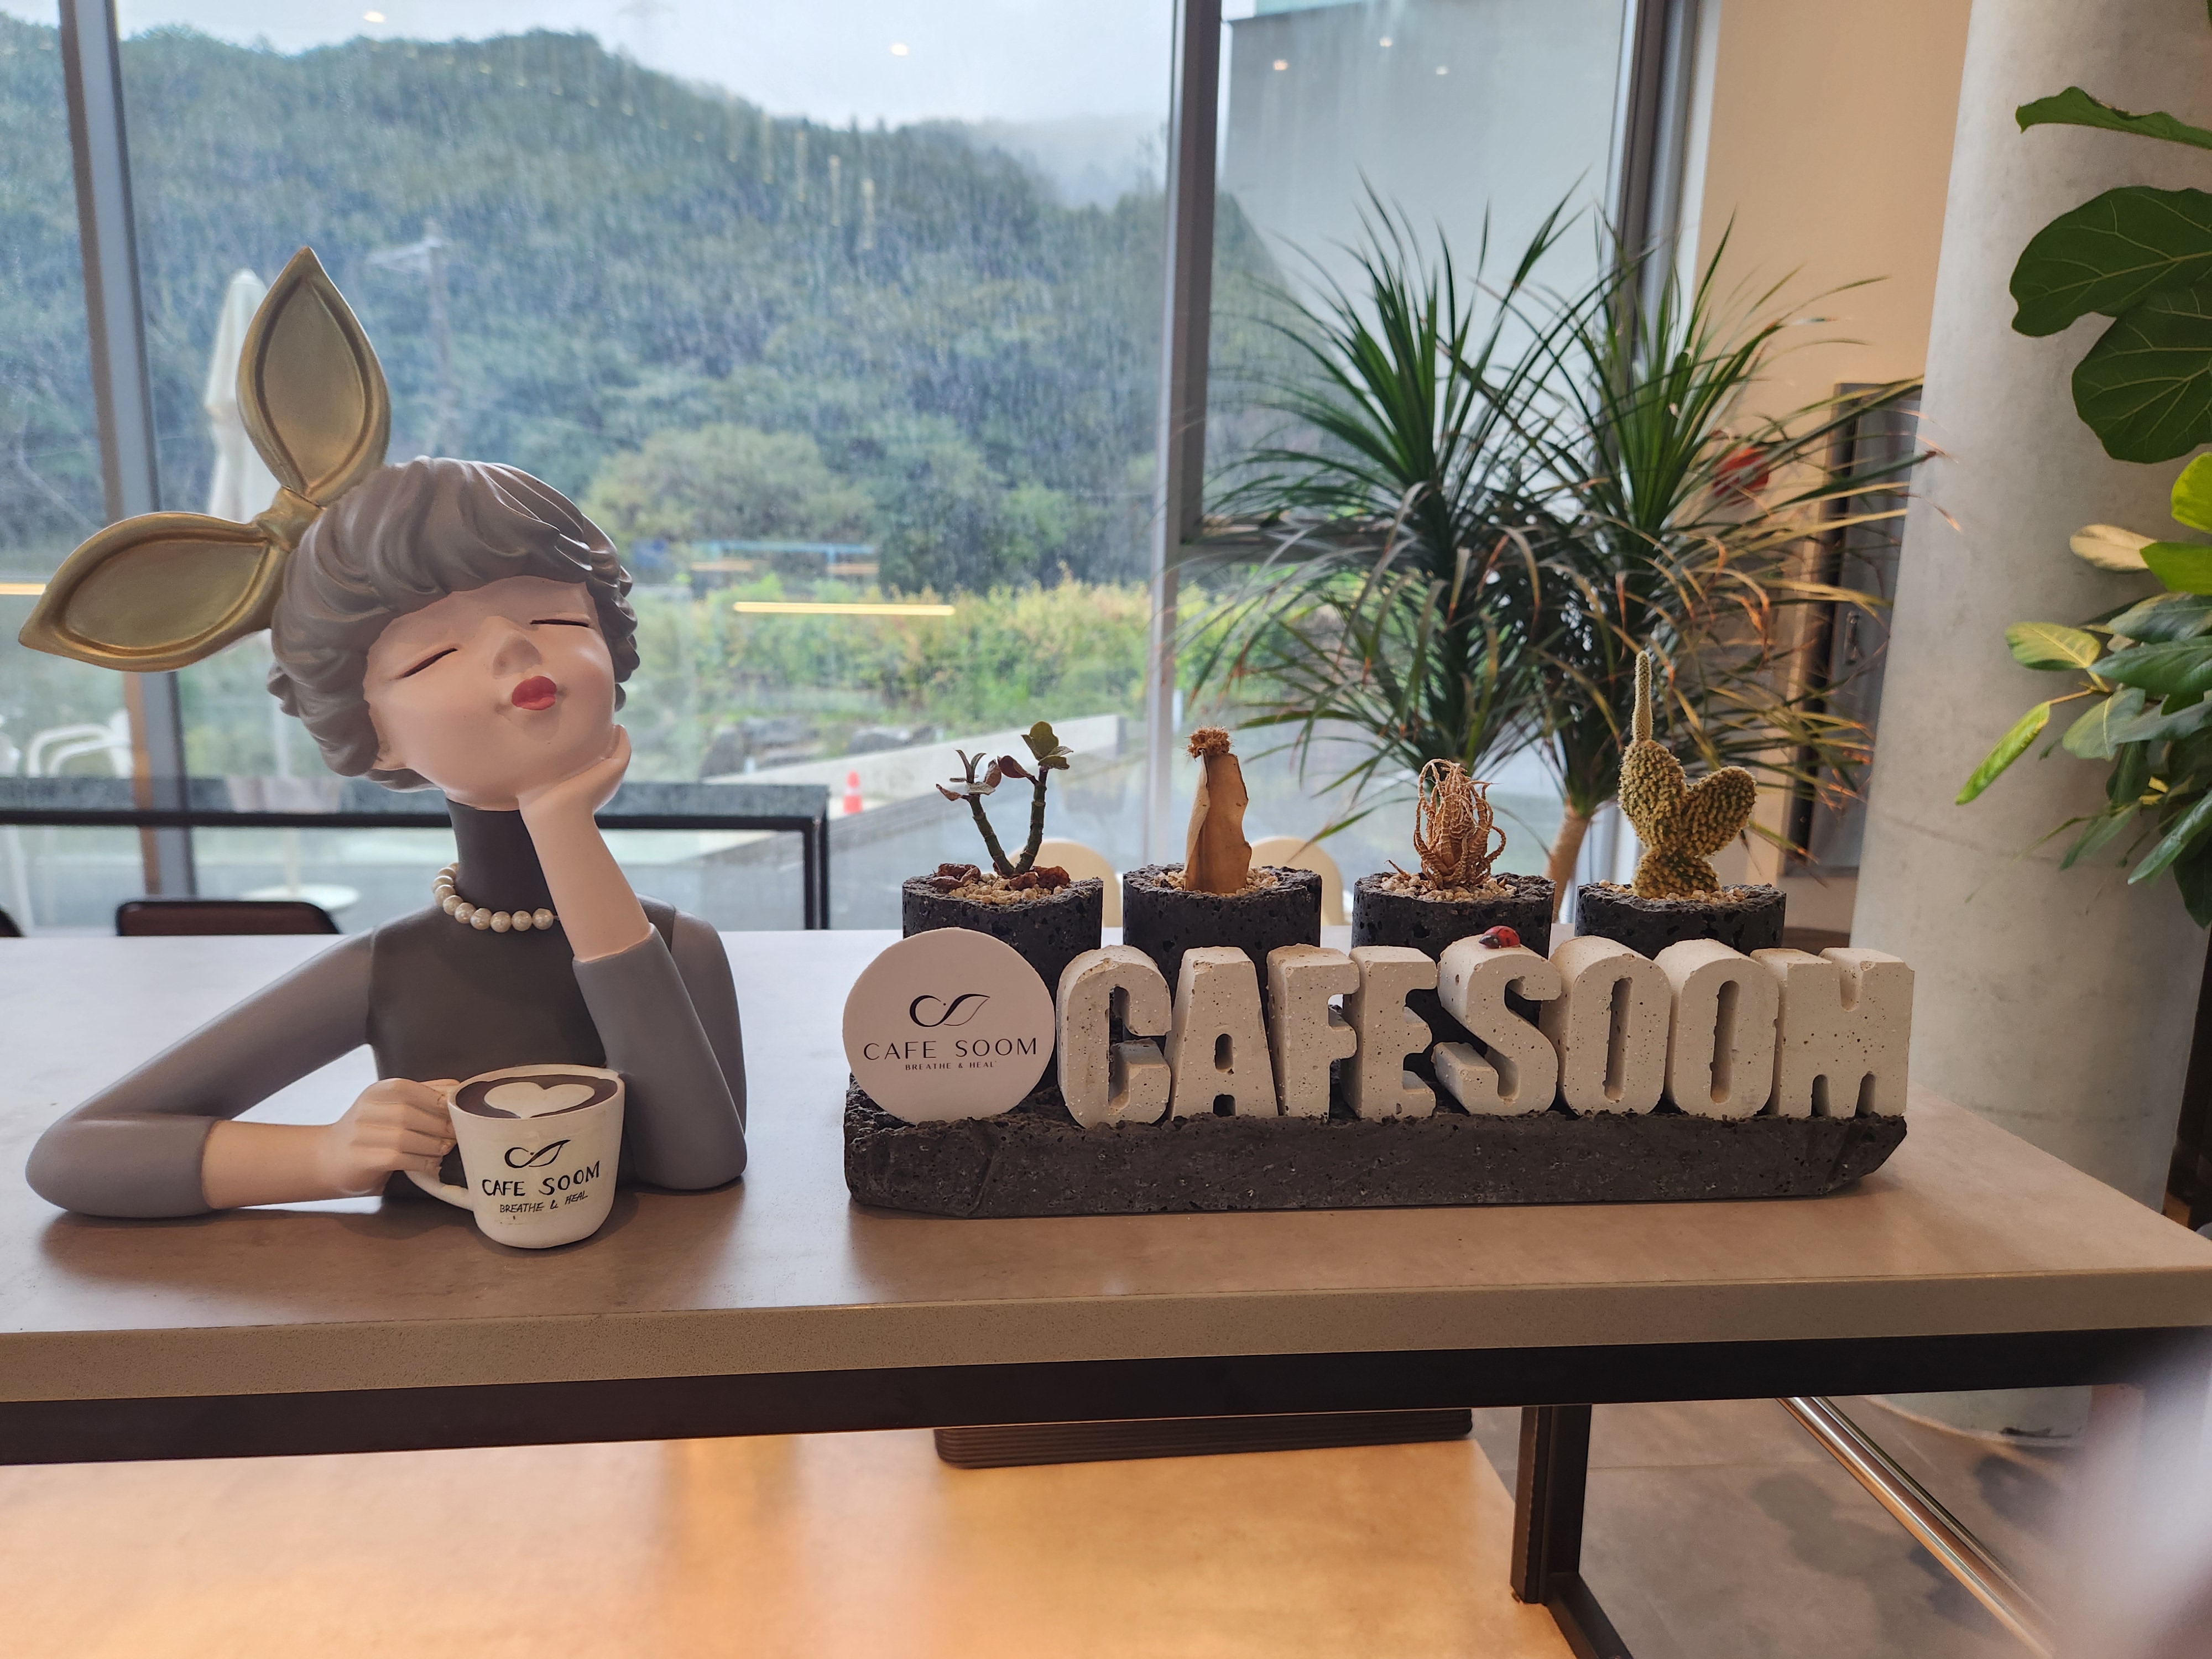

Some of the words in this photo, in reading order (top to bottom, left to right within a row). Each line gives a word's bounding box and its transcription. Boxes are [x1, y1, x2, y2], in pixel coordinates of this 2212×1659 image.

[863, 1041, 937, 1061] CAFE
[955, 1037, 1037, 1057] SOOM
[905, 1062, 952, 1071] BREATHE
[482, 1179, 526, 1196] CAFE
[539, 1160, 600, 1195] SOOM
[500, 1202, 544, 1213] BREATHE
[550, 1199, 559, 1209] &
[565, 1191, 588, 1204] HEAL
